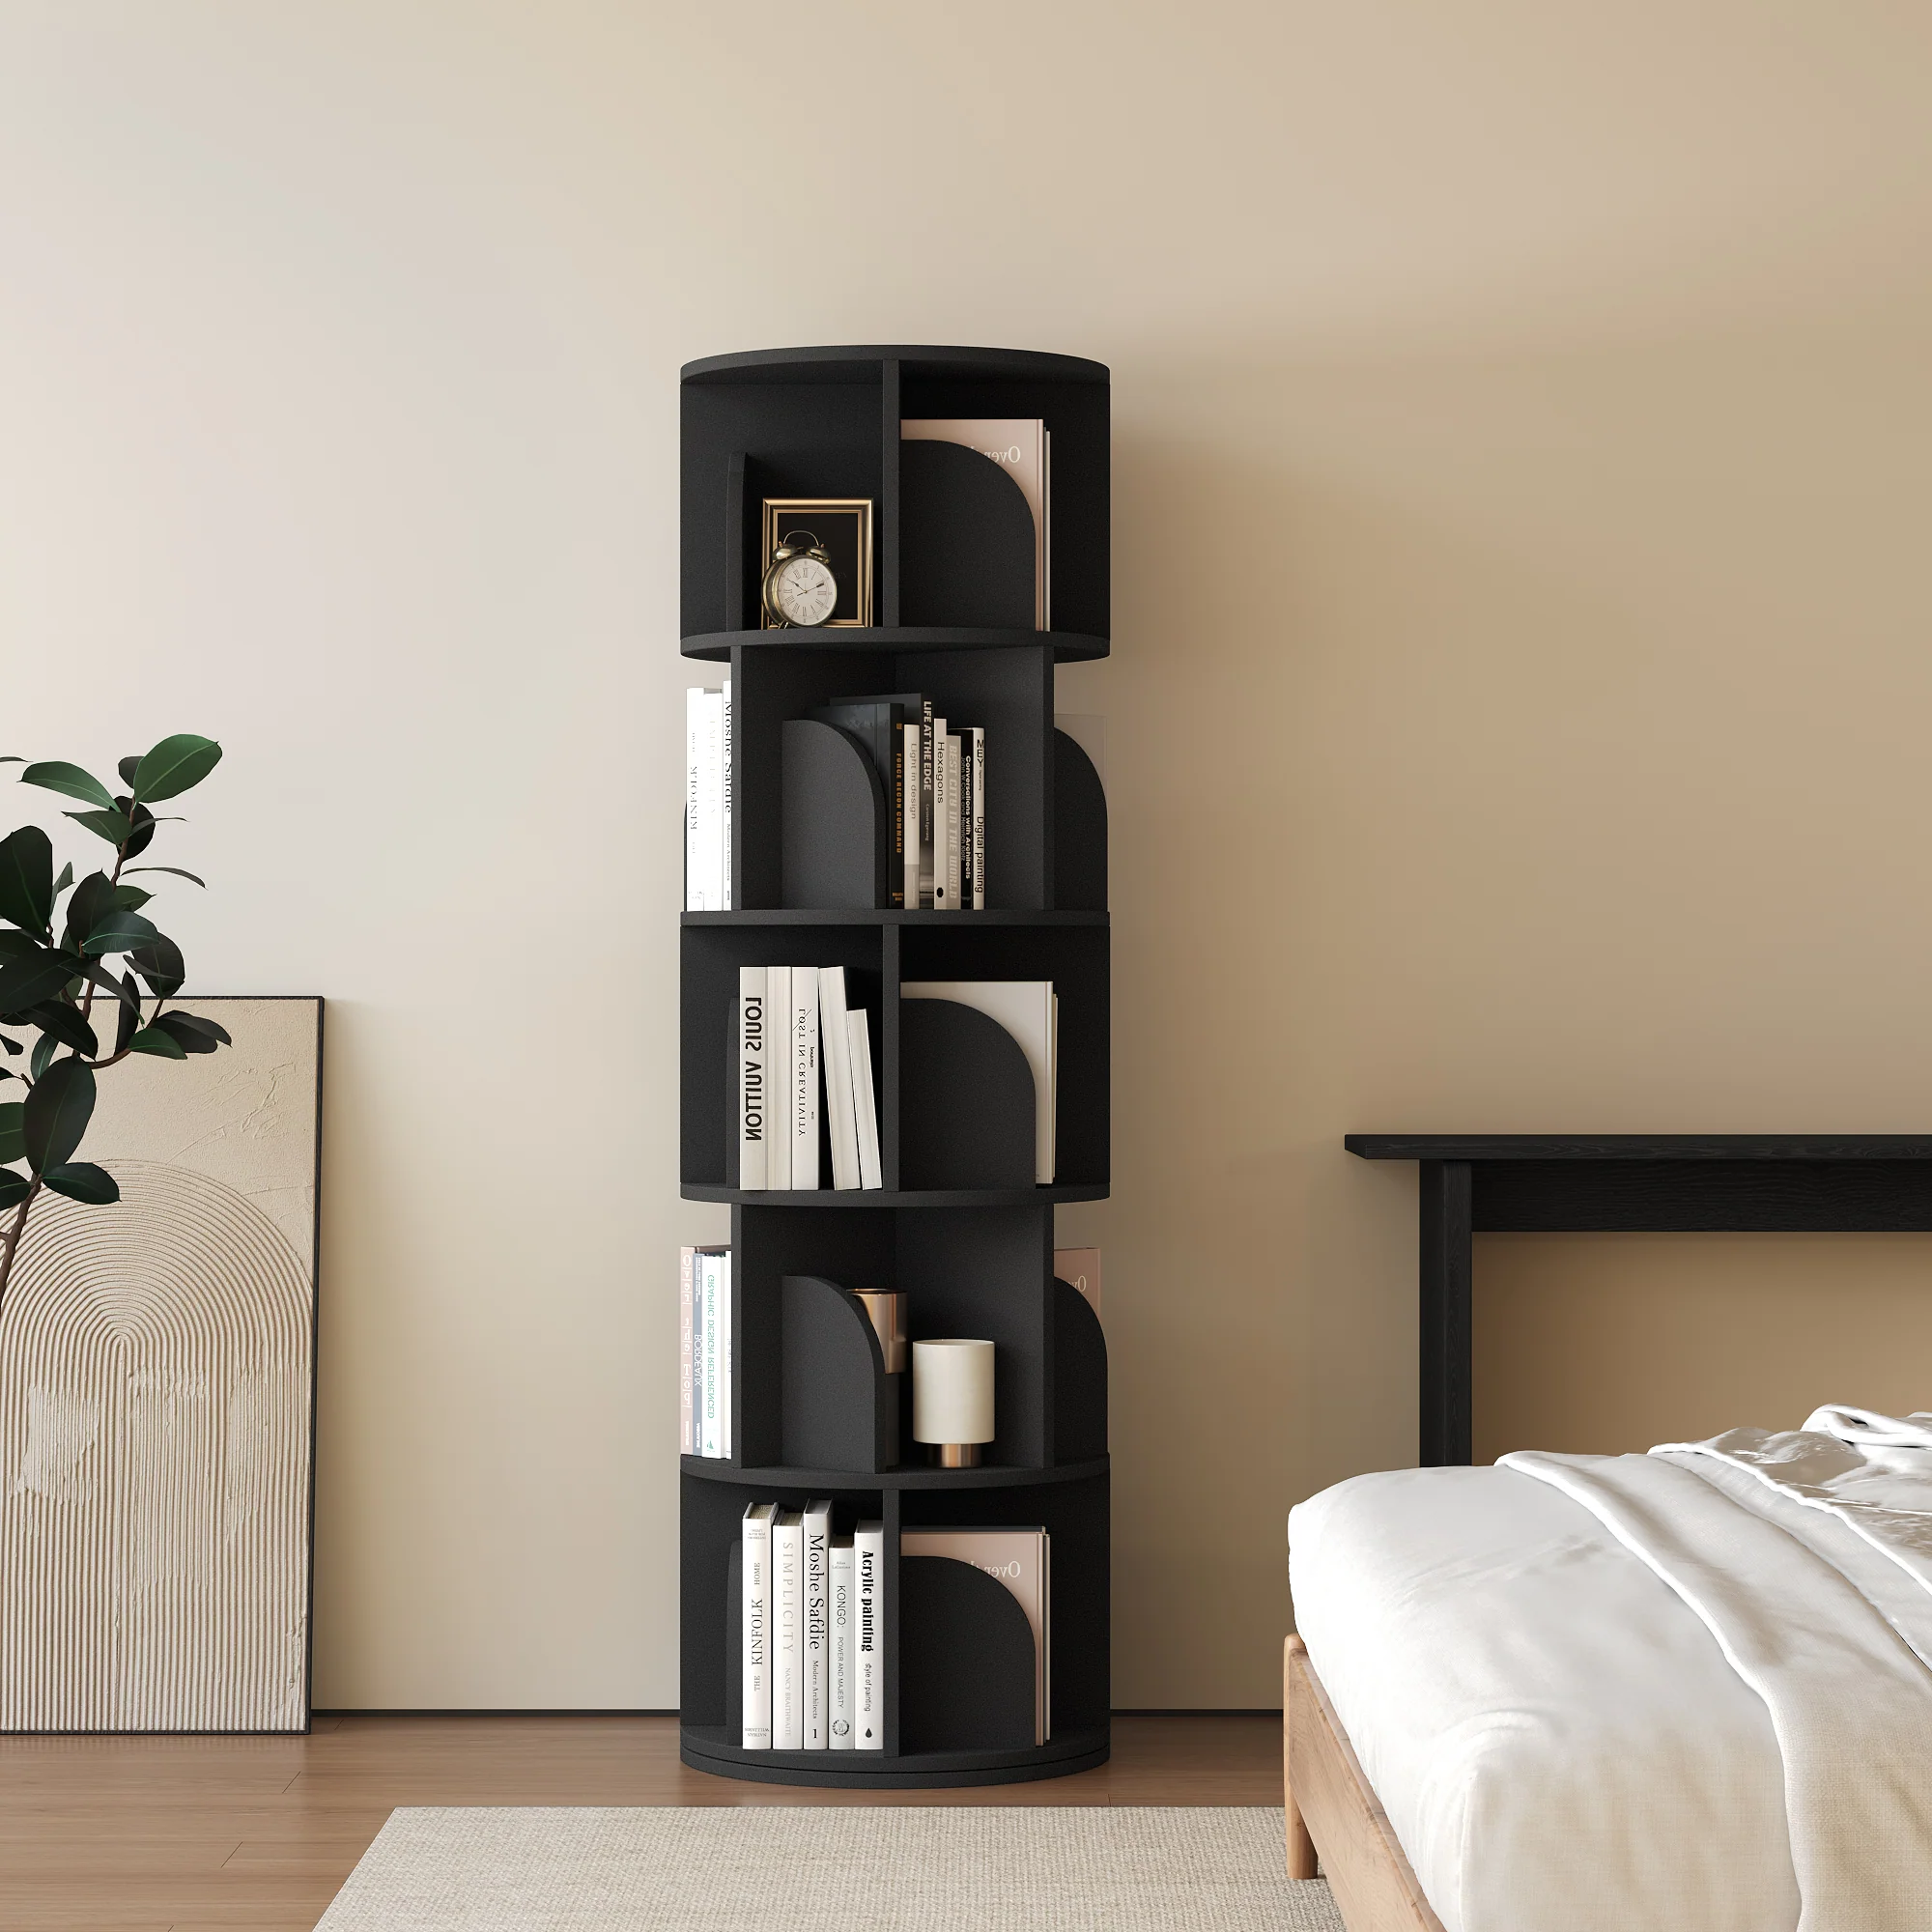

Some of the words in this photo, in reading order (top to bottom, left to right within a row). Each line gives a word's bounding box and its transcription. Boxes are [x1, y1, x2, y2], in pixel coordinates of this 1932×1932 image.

[923, 701, 932, 723] LIFE
[923, 724, 932, 739] AT
[923, 740, 932, 760] THE
[911, 772, 917, 781] in
[923, 762, 932, 791] EDGE
[936, 742, 945, 804] Hexagons
[949, 744, 957, 776] BEST
[949, 778, 957, 807] CITY
[949, 827, 957, 851] THE
[975, 816, 984, 849] Digital
[949, 854, 957, 899] WORLD
[975, 852, 984, 893] painting
[809, 1534, 825, 1592] Moshe
[862, 1550, 874, 1594] Acrylic
[782, 1542, 794, 1653] SIMPLICITY
[837, 1585, 847, 1628] KONGO:
[752, 1599, 763, 1665] KINFOLK
[809, 1597, 825, 1650] Safdie
[862, 1598, 874, 1652] painting
[812, 1728, 818, 1739] 1
